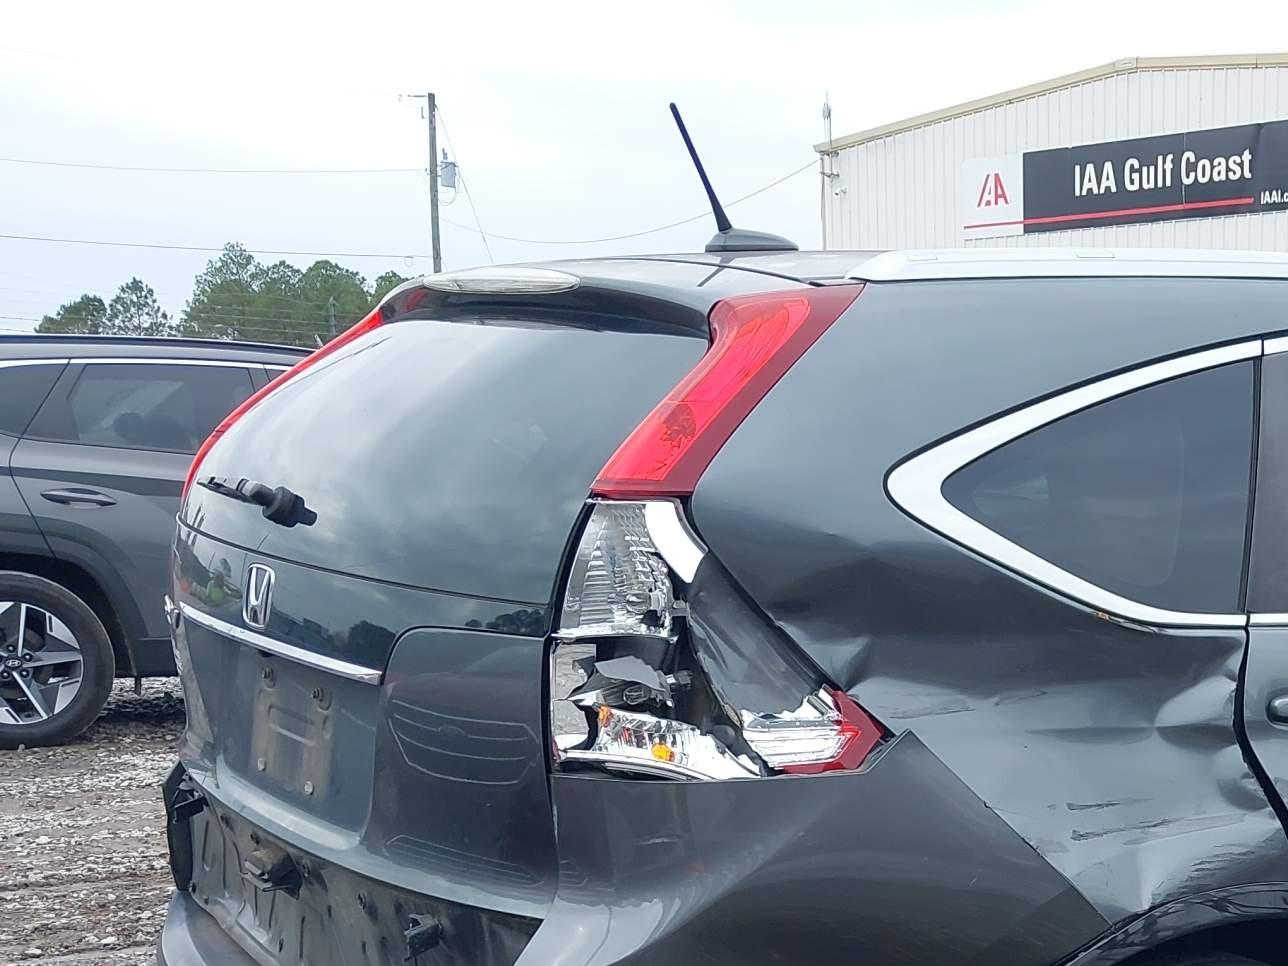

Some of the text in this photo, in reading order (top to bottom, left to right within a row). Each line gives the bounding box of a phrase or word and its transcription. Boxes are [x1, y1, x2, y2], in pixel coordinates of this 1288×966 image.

[1074, 147, 1252, 197] IAA Gulf Coast
